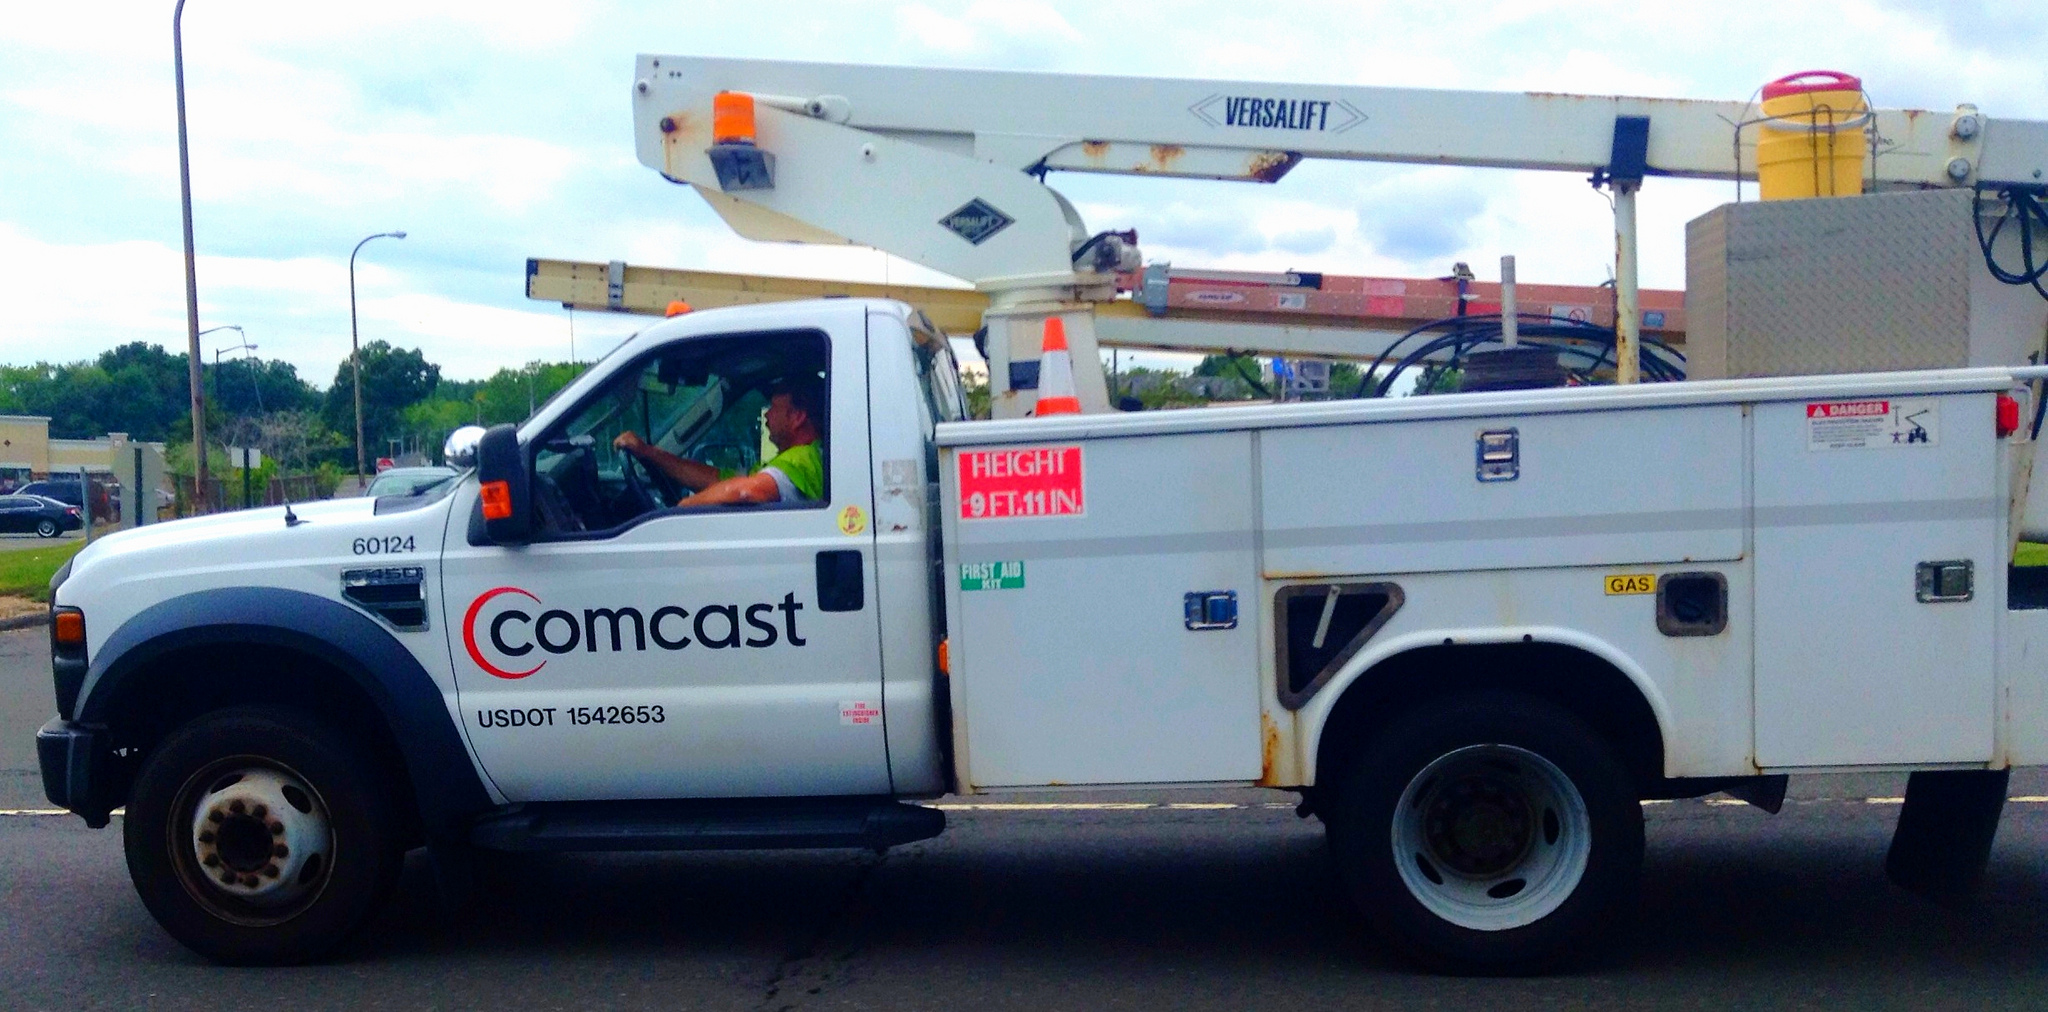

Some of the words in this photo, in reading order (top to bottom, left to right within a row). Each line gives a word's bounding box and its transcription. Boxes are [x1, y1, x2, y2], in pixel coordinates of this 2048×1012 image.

[1226, 97, 1331, 131] VERSALIFT
[1829, 403, 1884, 416] DANGER
[972, 449, 1064, 478] HEIGHT
[352, 534, 416, 556] 60124
[961, 563, 994, 580] FIRST
[1001, 561, 1022, 577] AID
[981, 580, 1002, 589] KIT
[1611, 578, 1650, 592] GAS
[490, 591, 806, 656] comcast
[478, 709, 557, 728] USDOT
[567, 705, 666, 725] 1542653
